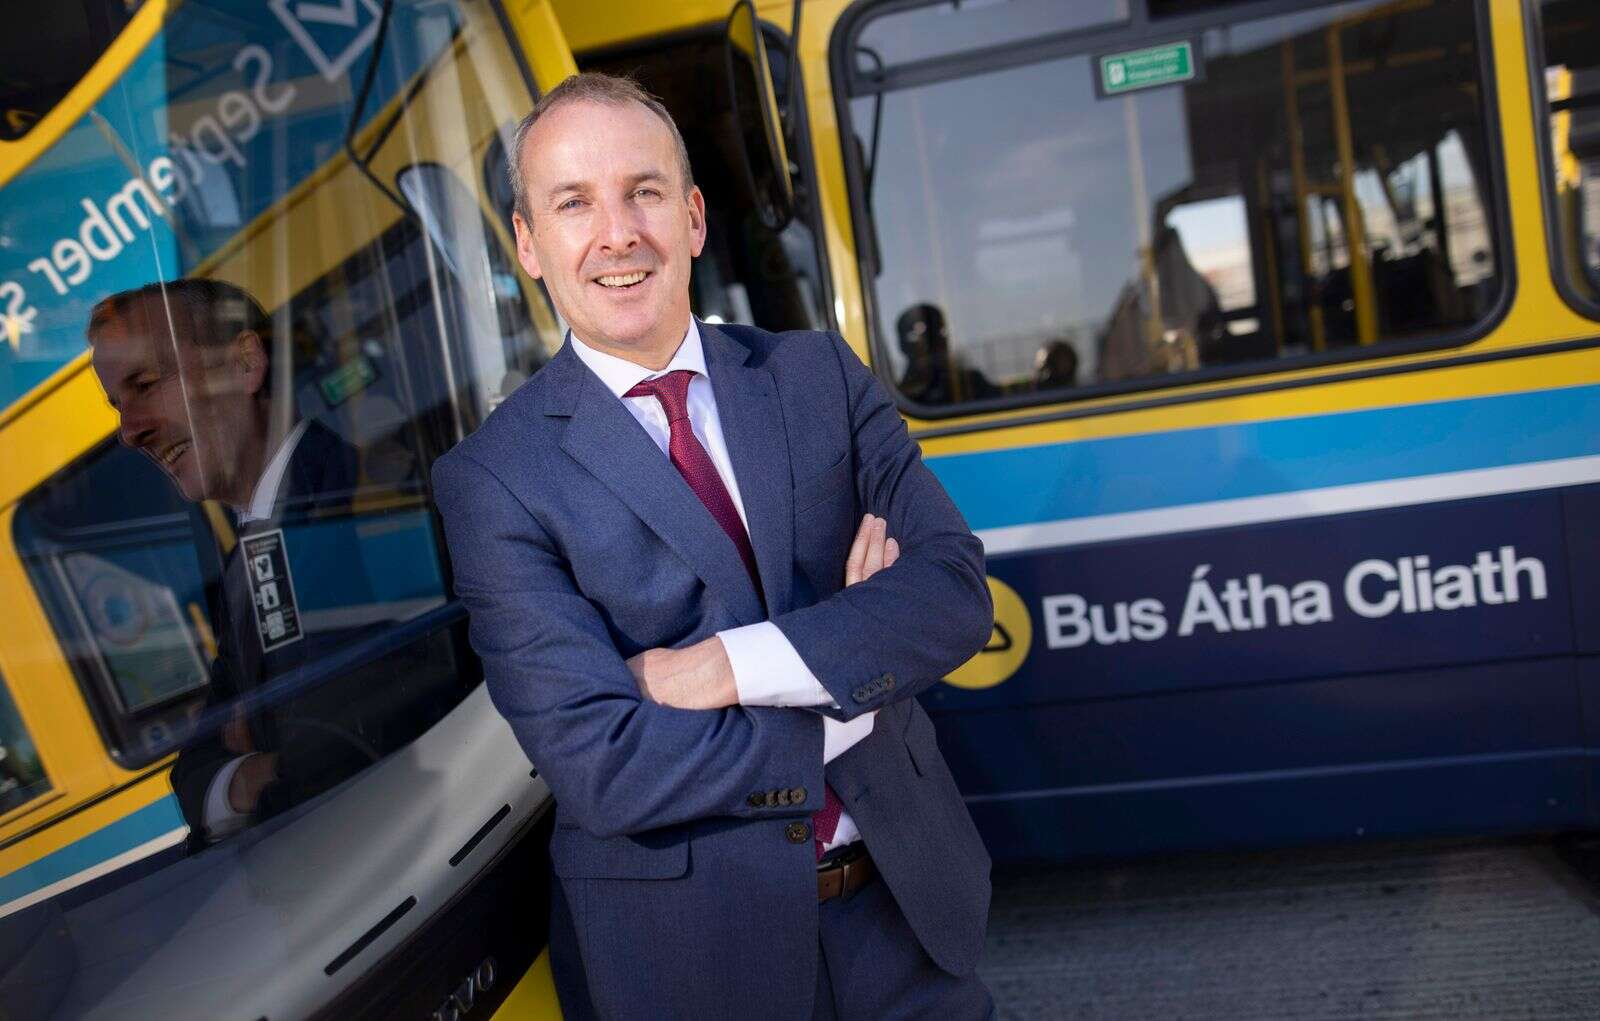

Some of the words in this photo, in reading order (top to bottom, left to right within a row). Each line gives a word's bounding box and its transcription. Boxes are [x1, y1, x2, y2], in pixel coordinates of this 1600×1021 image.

[1042, 594, 1168, 650] Bus
[1178, 565, 1333, 636] Átha
[1344, 545, 1548, 618] Cliath
